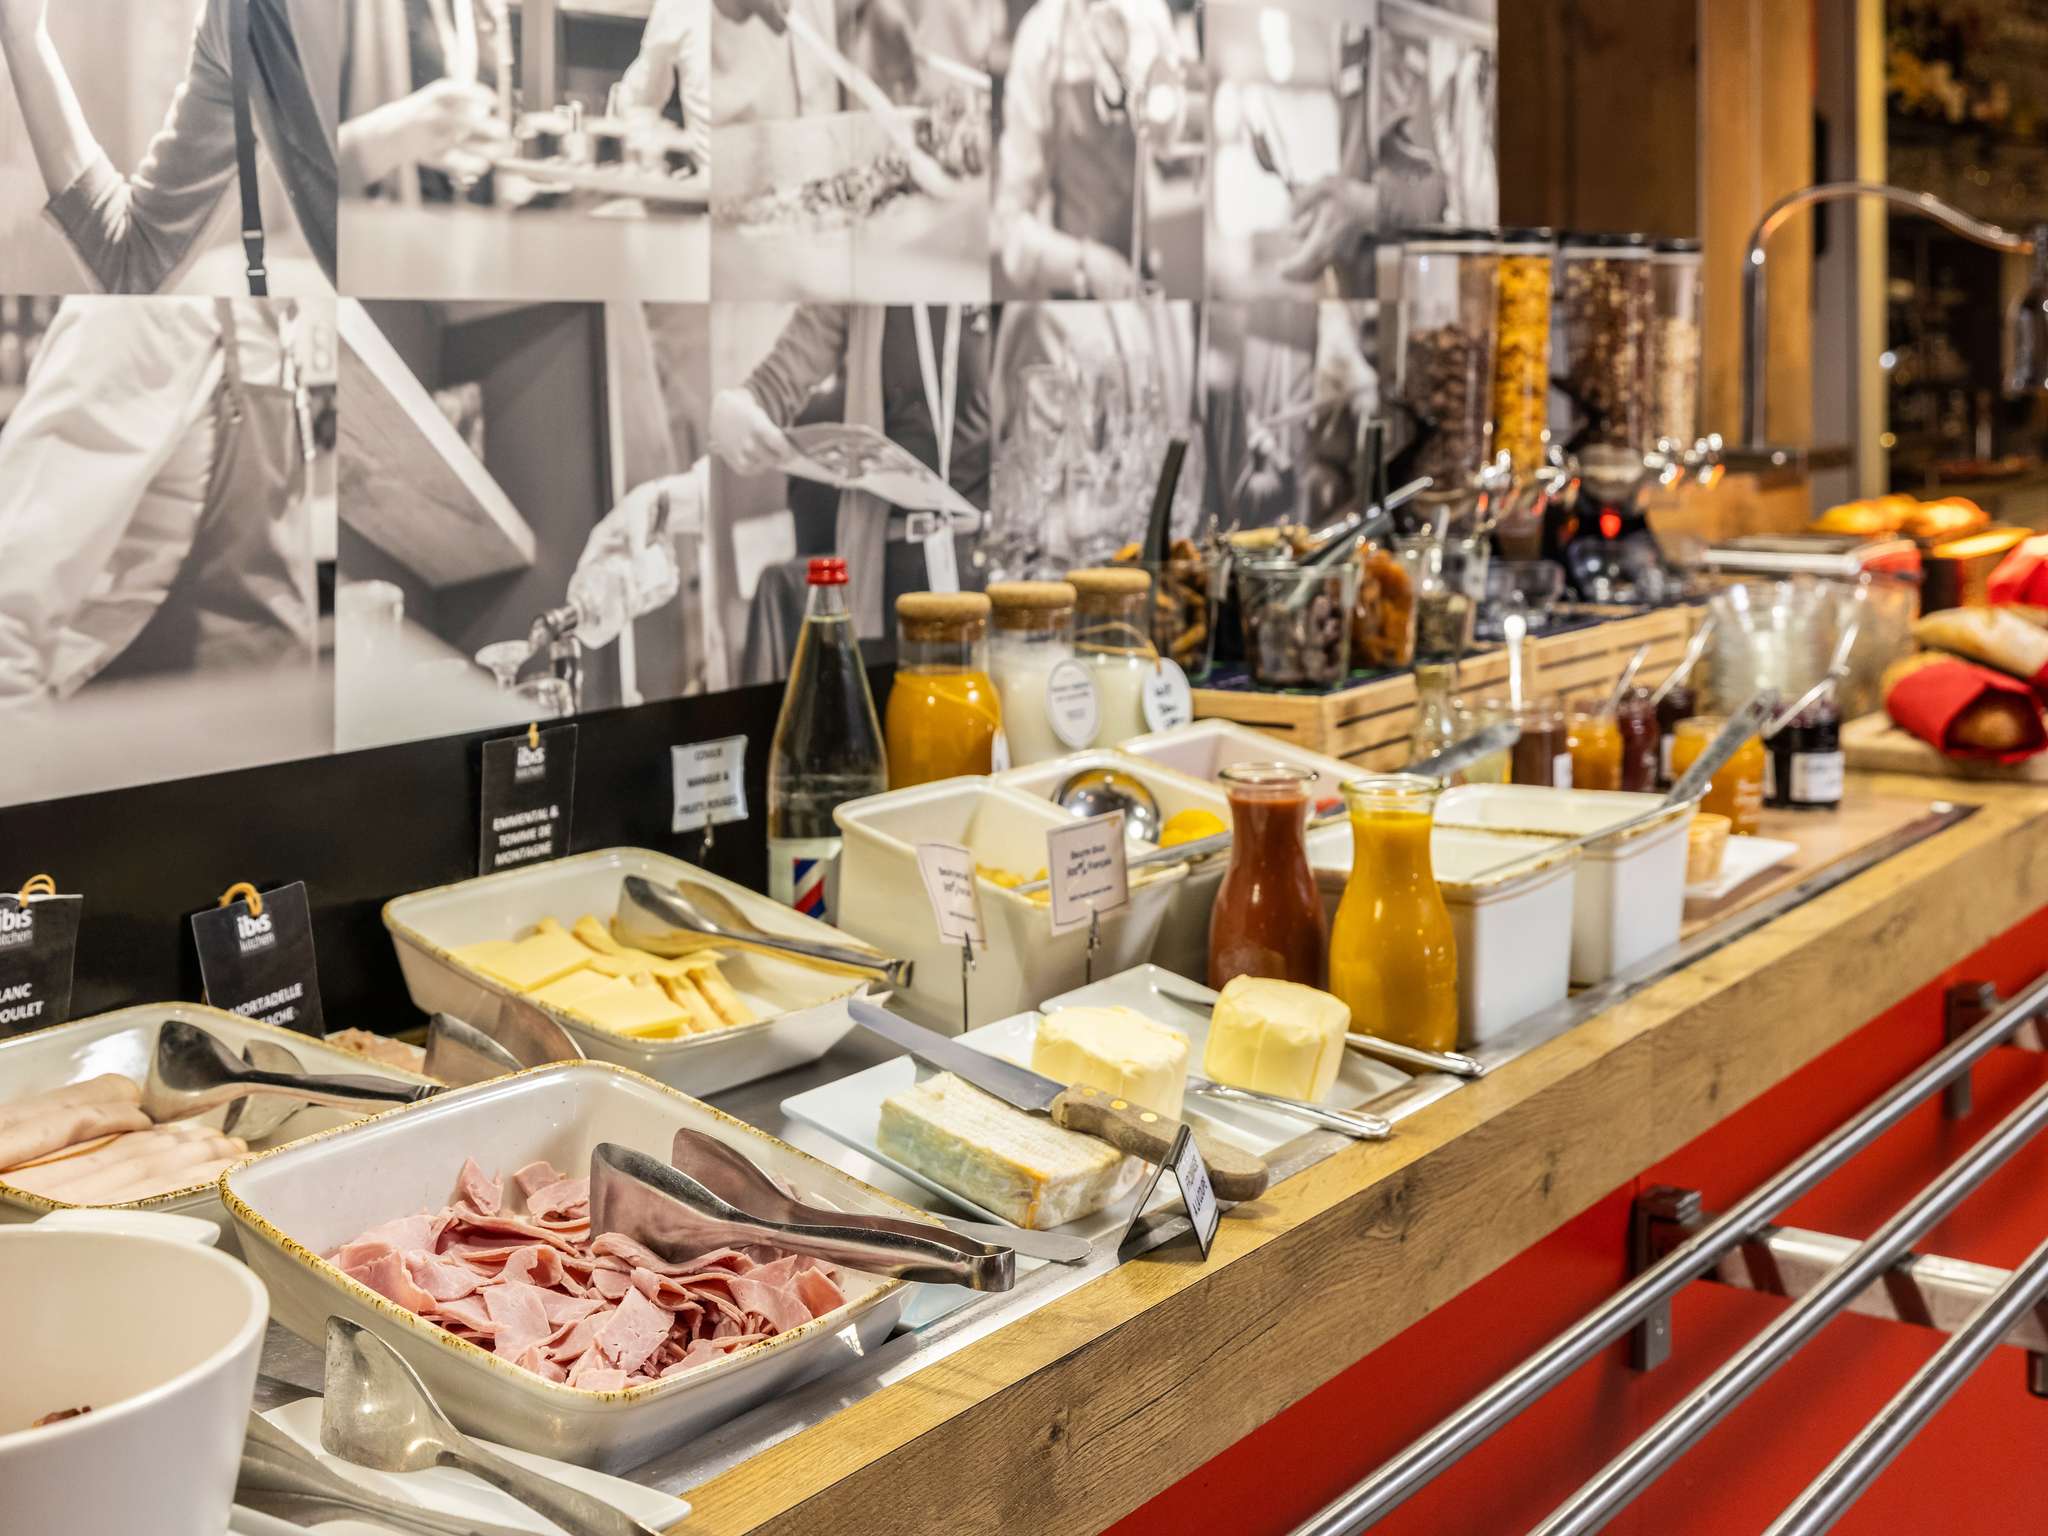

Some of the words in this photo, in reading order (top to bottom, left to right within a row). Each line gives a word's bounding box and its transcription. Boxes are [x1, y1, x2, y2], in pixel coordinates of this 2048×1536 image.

[0, 907, 32, 932] bis
[236, 913, 272, 939] ibis
[0, 982, 33, 1004] LANC
[0, 1000, 45, 1024] OULET
